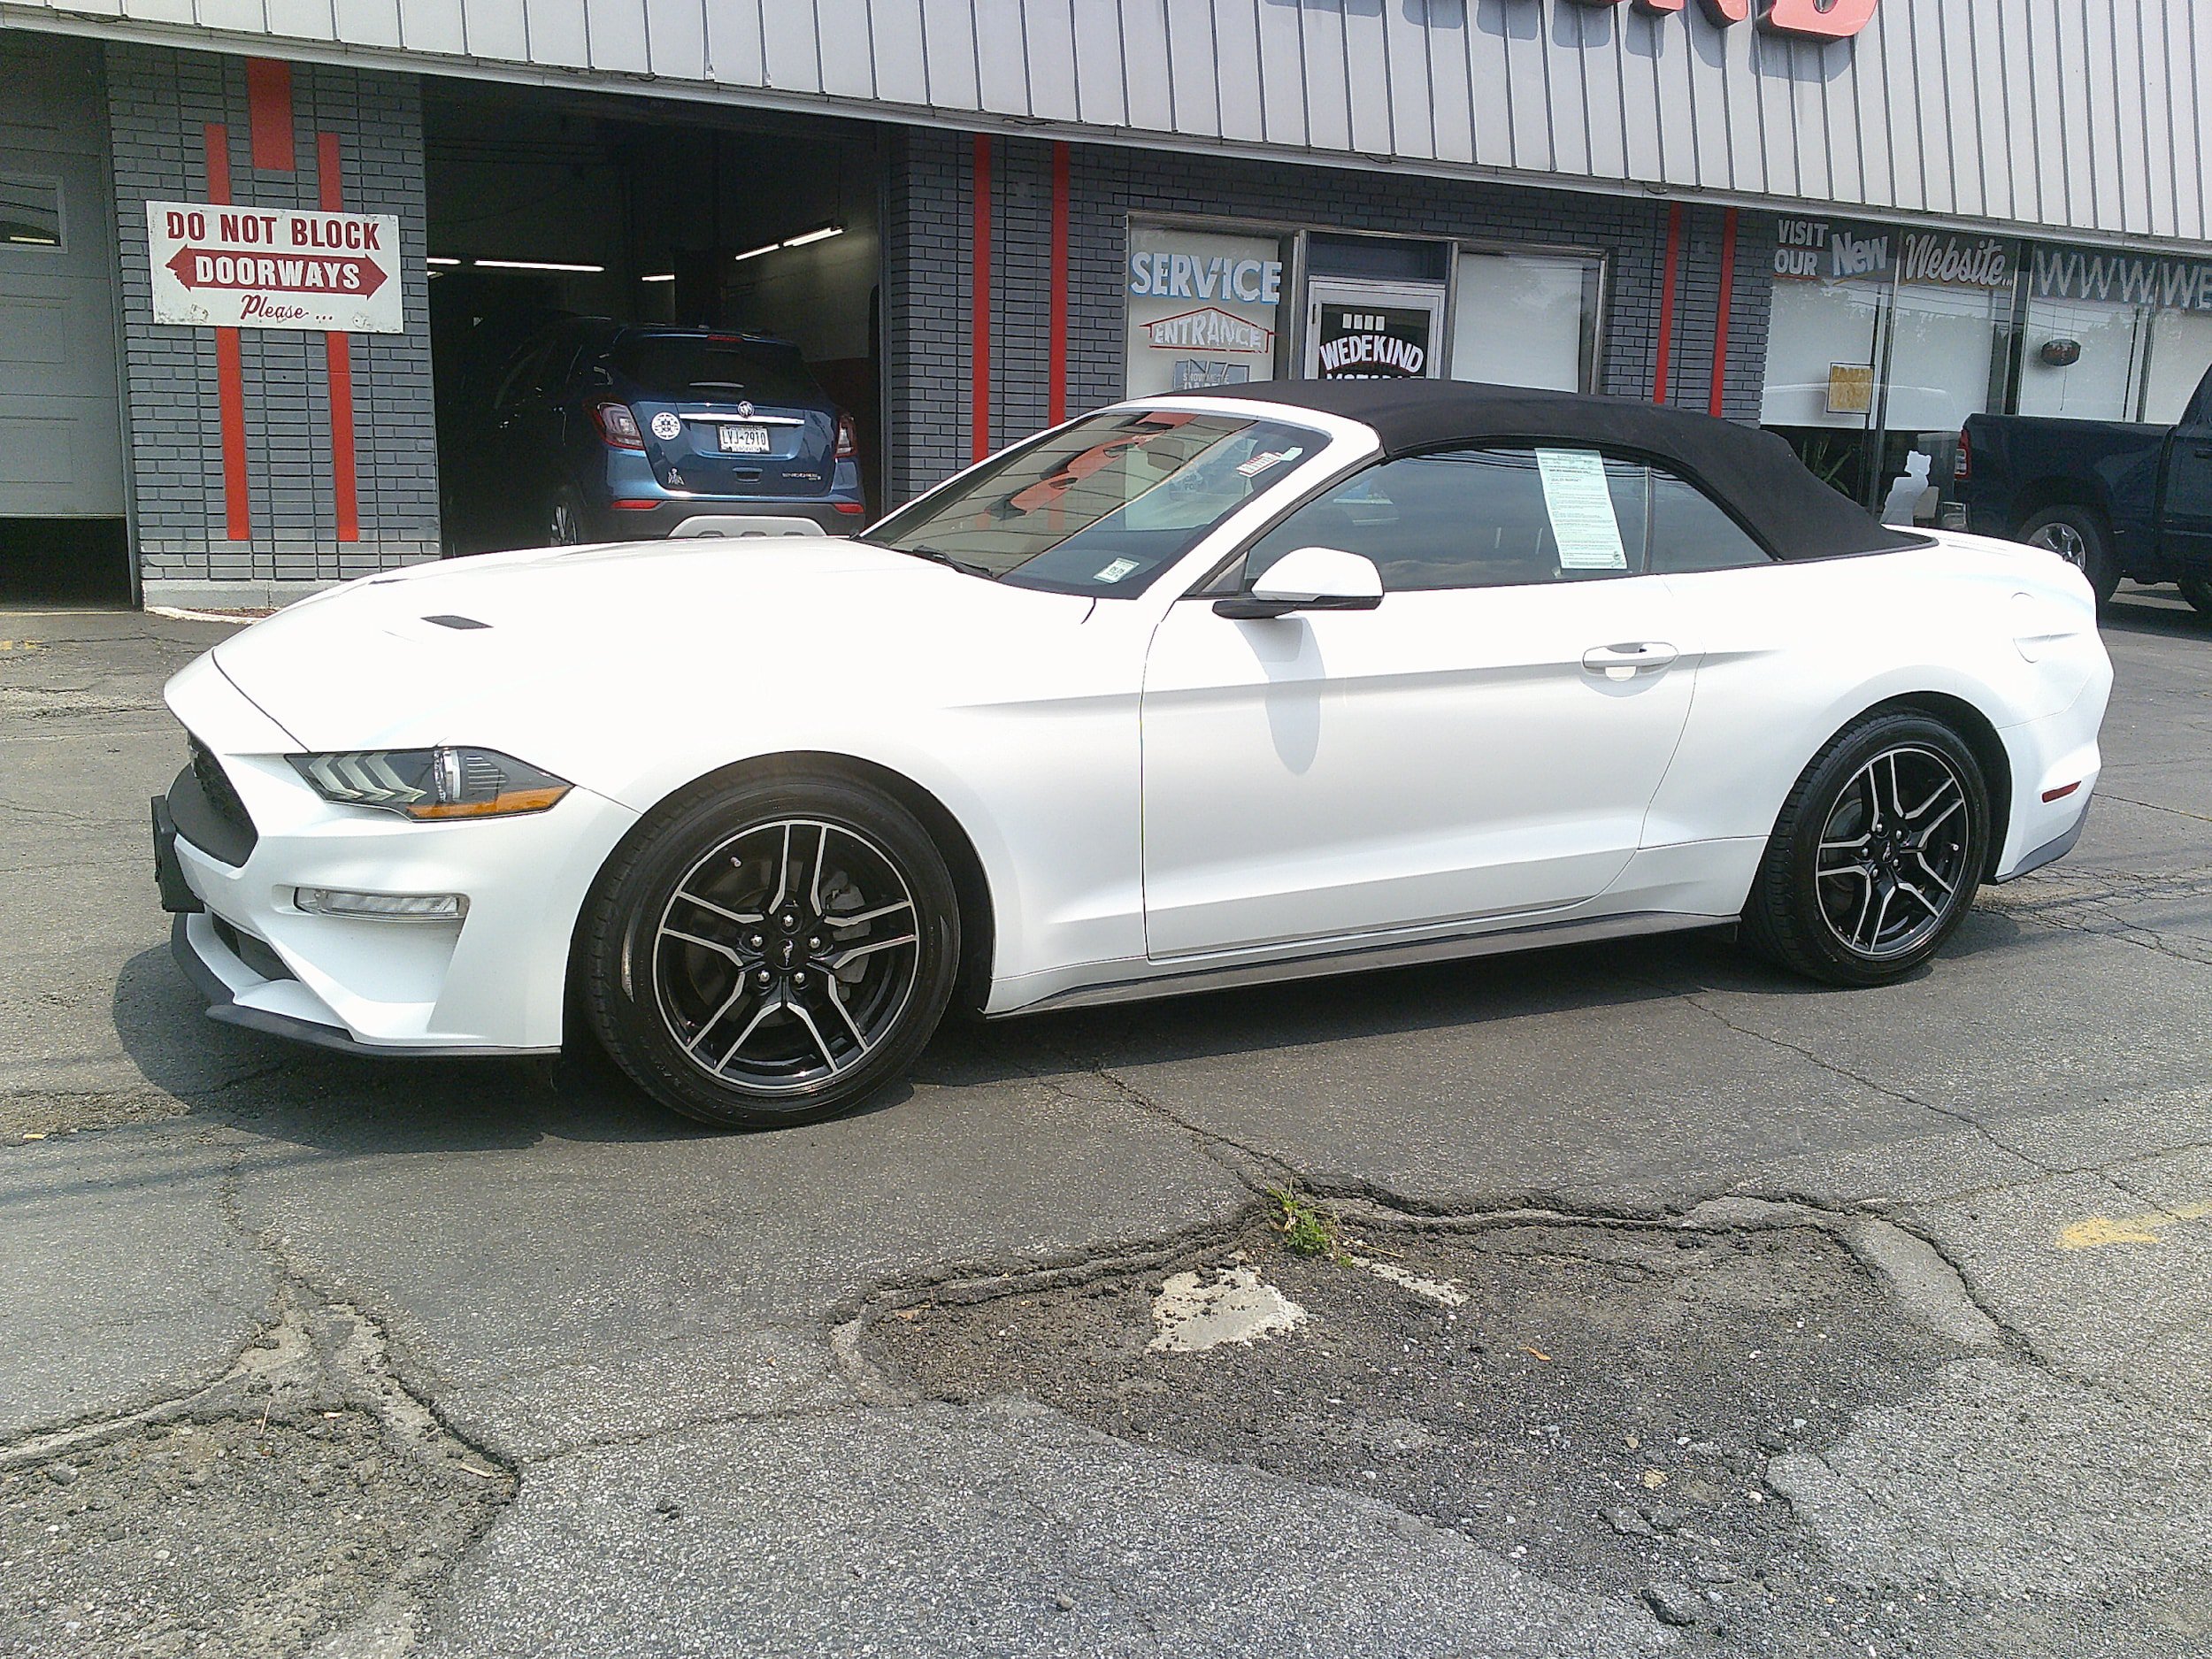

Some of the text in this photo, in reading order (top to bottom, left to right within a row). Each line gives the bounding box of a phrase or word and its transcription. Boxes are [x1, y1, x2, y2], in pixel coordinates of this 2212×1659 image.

[166, 211, 380, 250] DO NOT BLOCK
[1778, 219, 1829, 247] VISIT
[195, 256, 360, 289] DOORWAYS
[1774, 249, 1818, 276] OUR
[1832, 231, 1888, 277] New
[1131, 251, 1283, 304] SERVICE
[241, 295, 309, 320] Please
[1154, 311, 1262, 348] ENTRANCE
[1319, 334, 1425, 373] WEDEKIND
